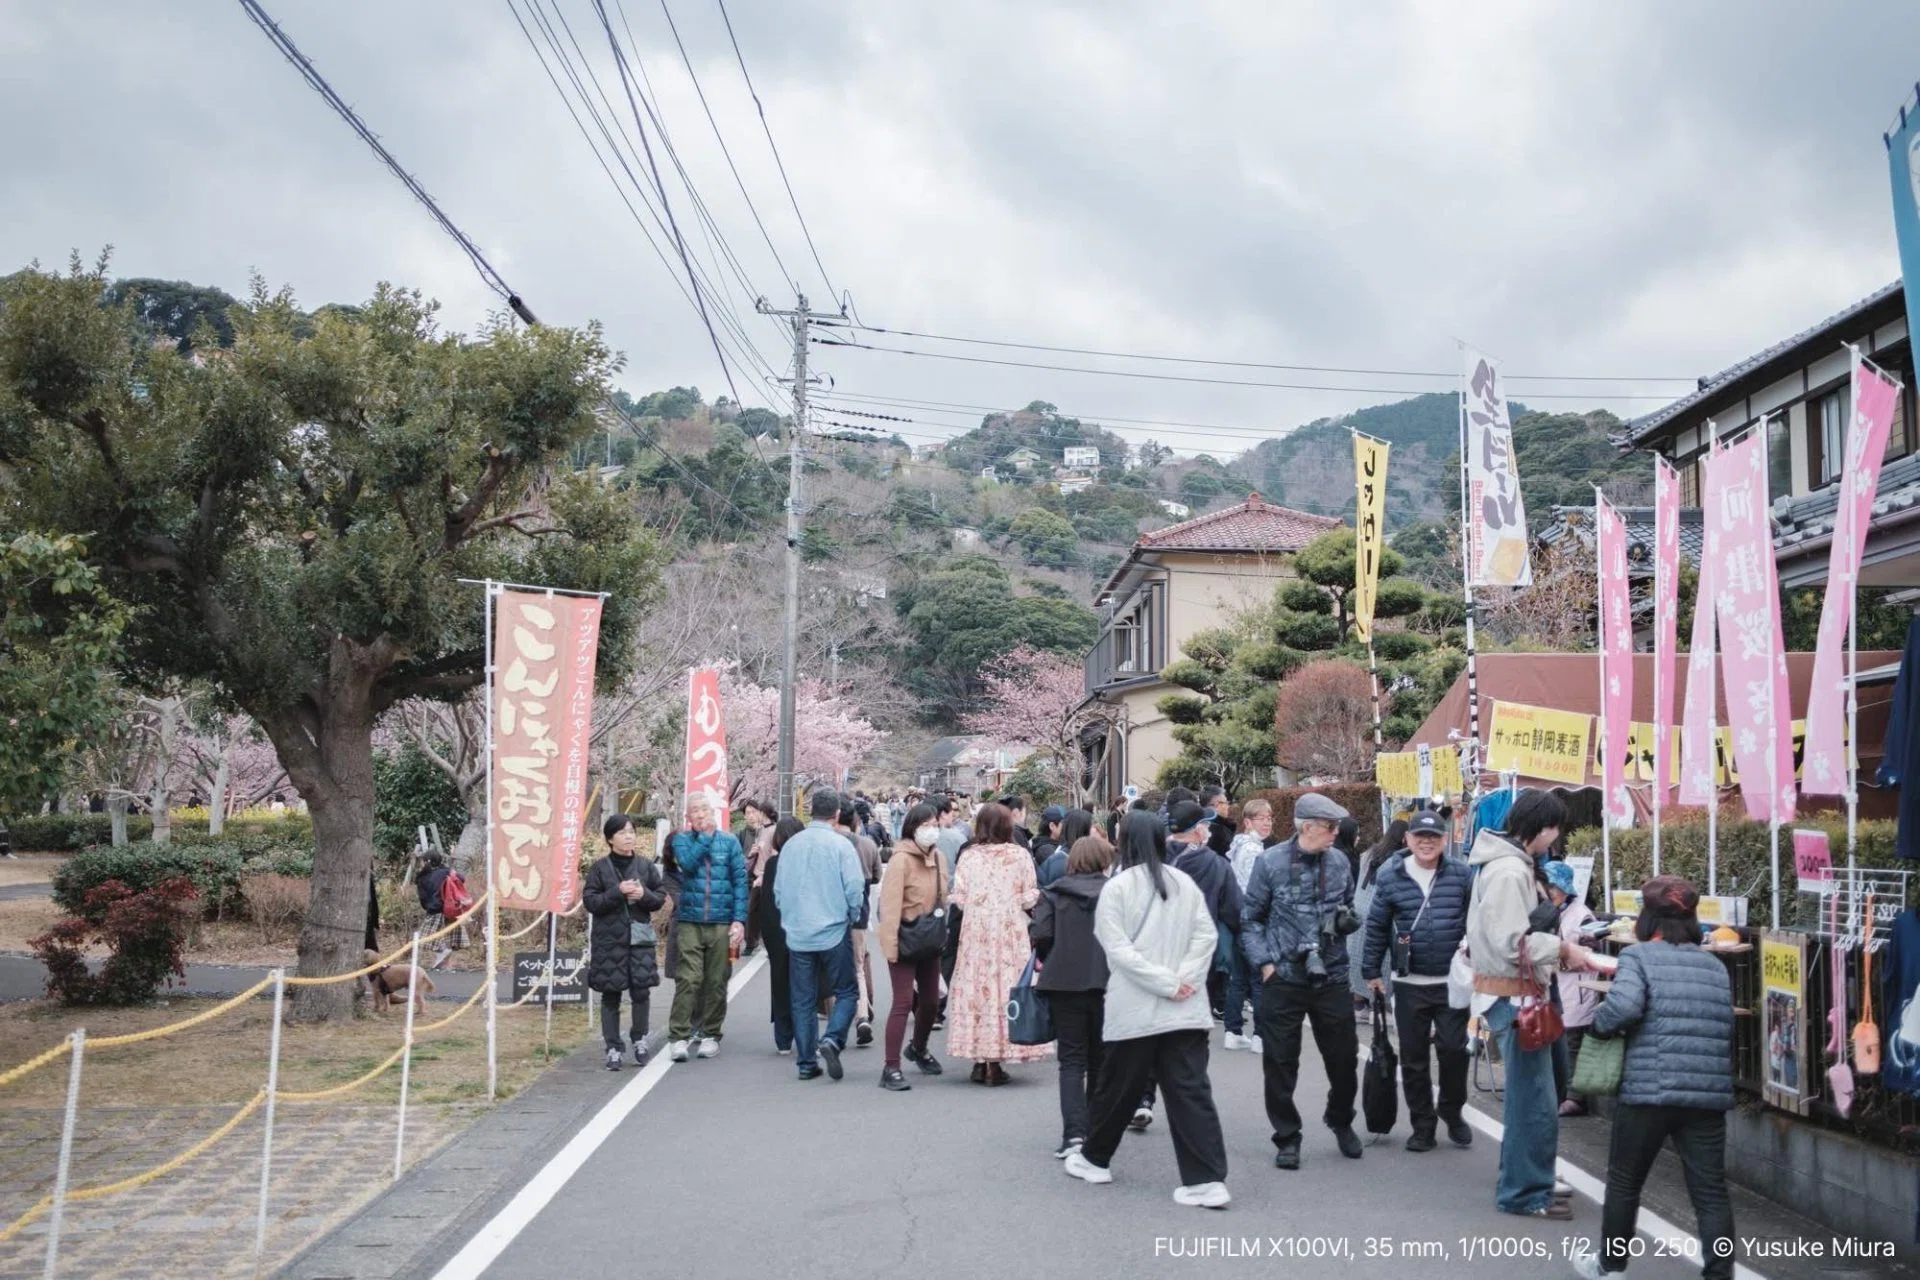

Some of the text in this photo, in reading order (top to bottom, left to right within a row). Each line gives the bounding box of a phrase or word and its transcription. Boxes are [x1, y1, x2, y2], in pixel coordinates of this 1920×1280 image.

[498, 603, 560, 901] こんにゃくおでん
[1495, 727, 1582, 757] サッポロ静岡麦酒
